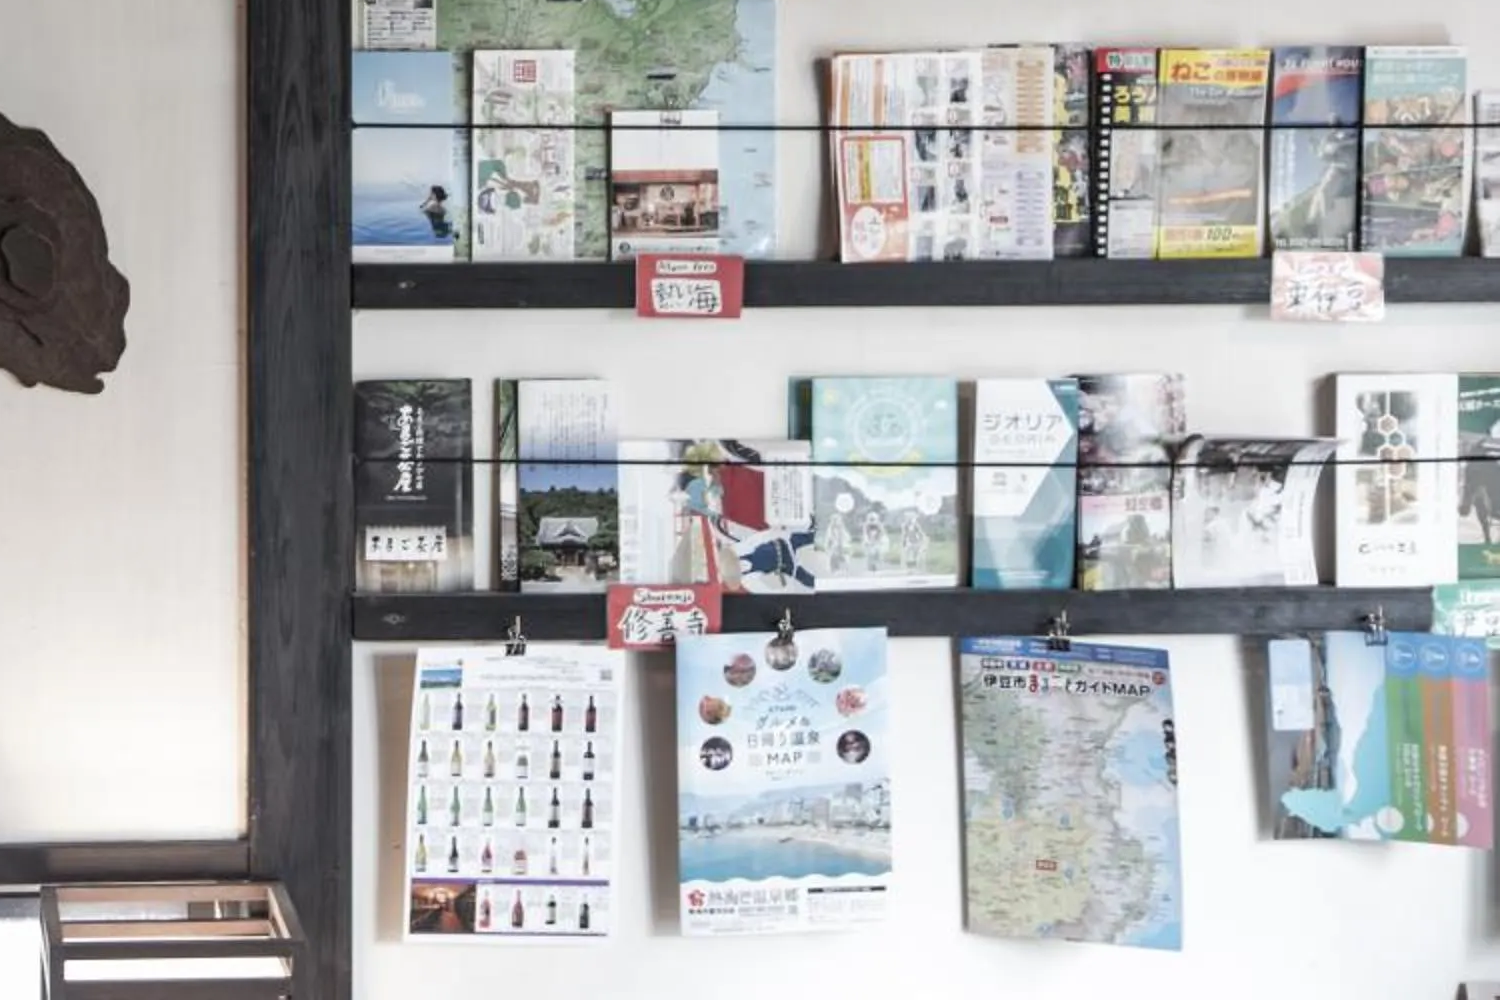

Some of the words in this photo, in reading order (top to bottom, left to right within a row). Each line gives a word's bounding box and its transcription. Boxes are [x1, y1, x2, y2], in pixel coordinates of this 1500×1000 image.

[983, 412, 1063, 432] ジオリア
[622, 609, 704, 642] 修善寺
[766, 751, 803, 766] MAP
